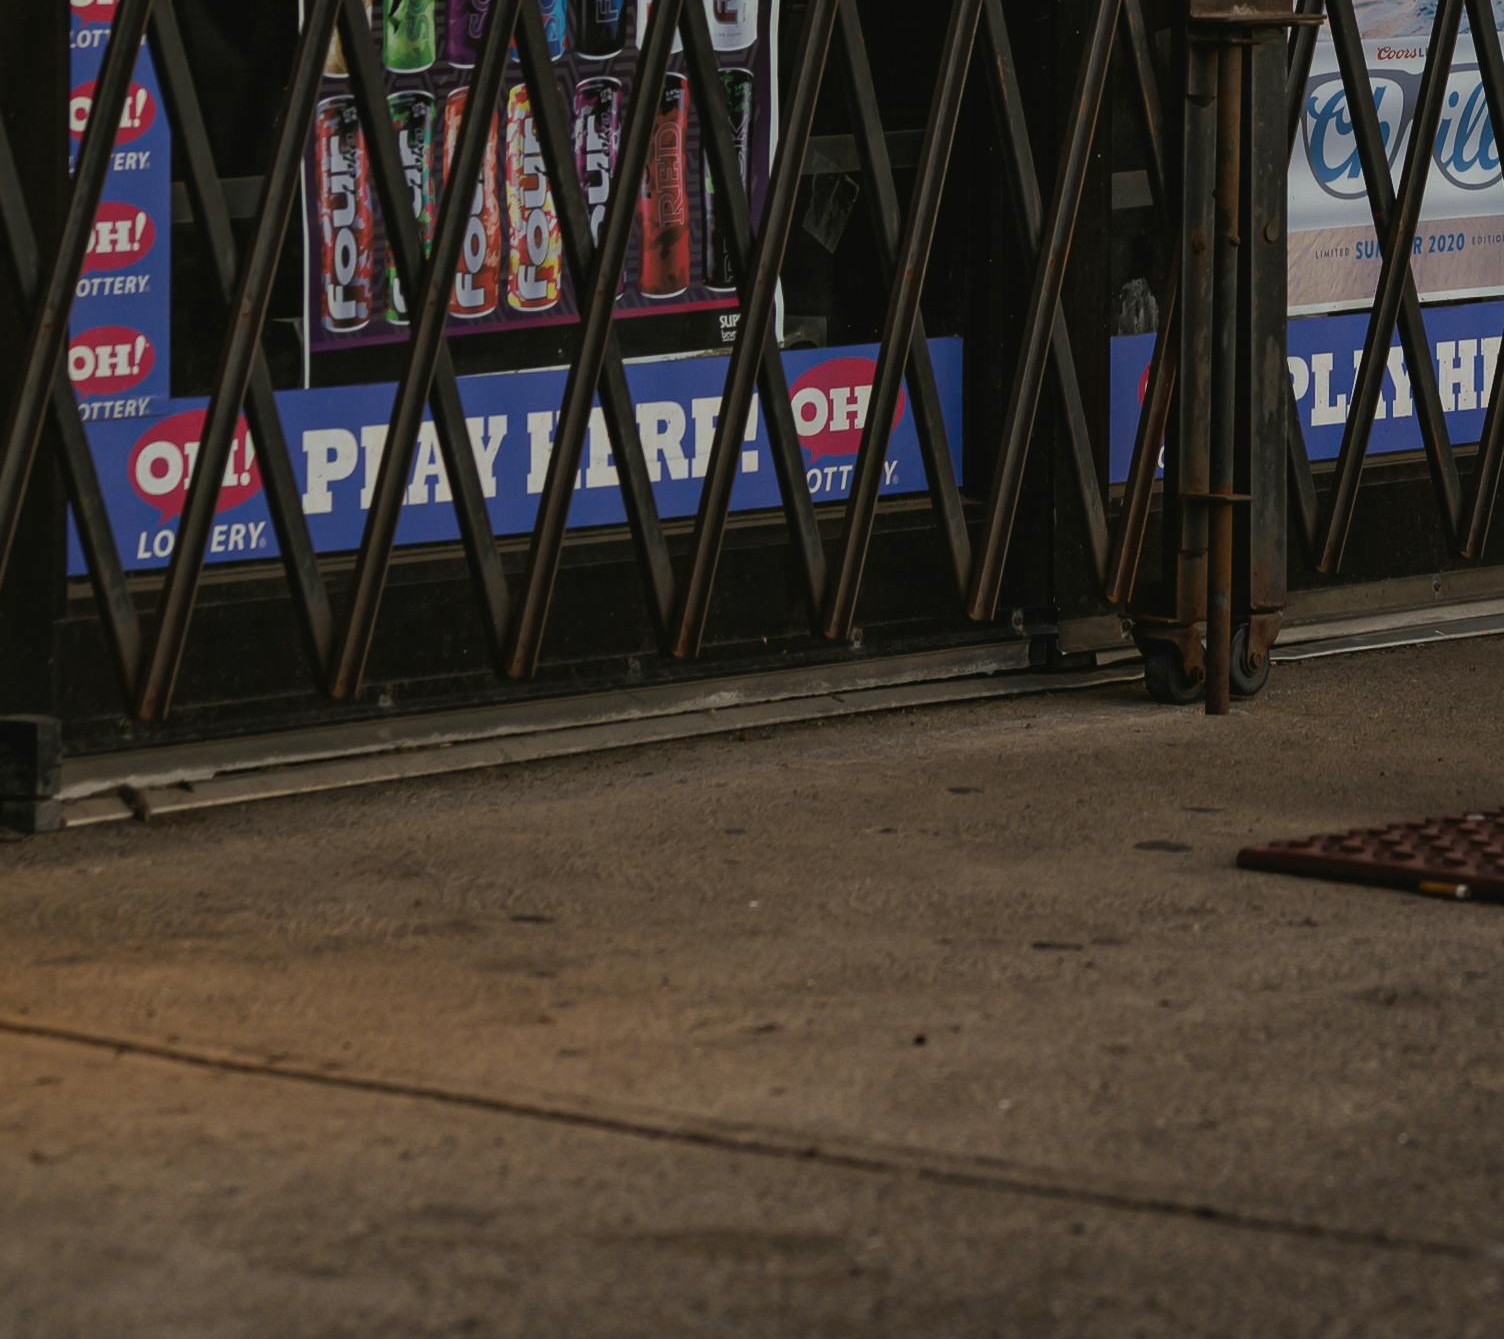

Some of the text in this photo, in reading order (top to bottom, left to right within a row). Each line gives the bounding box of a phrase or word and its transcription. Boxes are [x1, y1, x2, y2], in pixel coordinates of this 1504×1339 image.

[1376, 45, 1418, 61] Coors
[659, 122, 685, 229] RED
[325, 134, 360, 322] four
[1315, 247, 1350, 259] LIMITED
[1428, 233, 1465, 253] 2020
[76, 274, 151, 296] OTTERY
[68, 335, 150, 381] OH!
[78, 396, 151, 421] OTTERY
[302, 392, 760, 515] PLAY HERE!
[136, 522, 268, 559] LOERY
